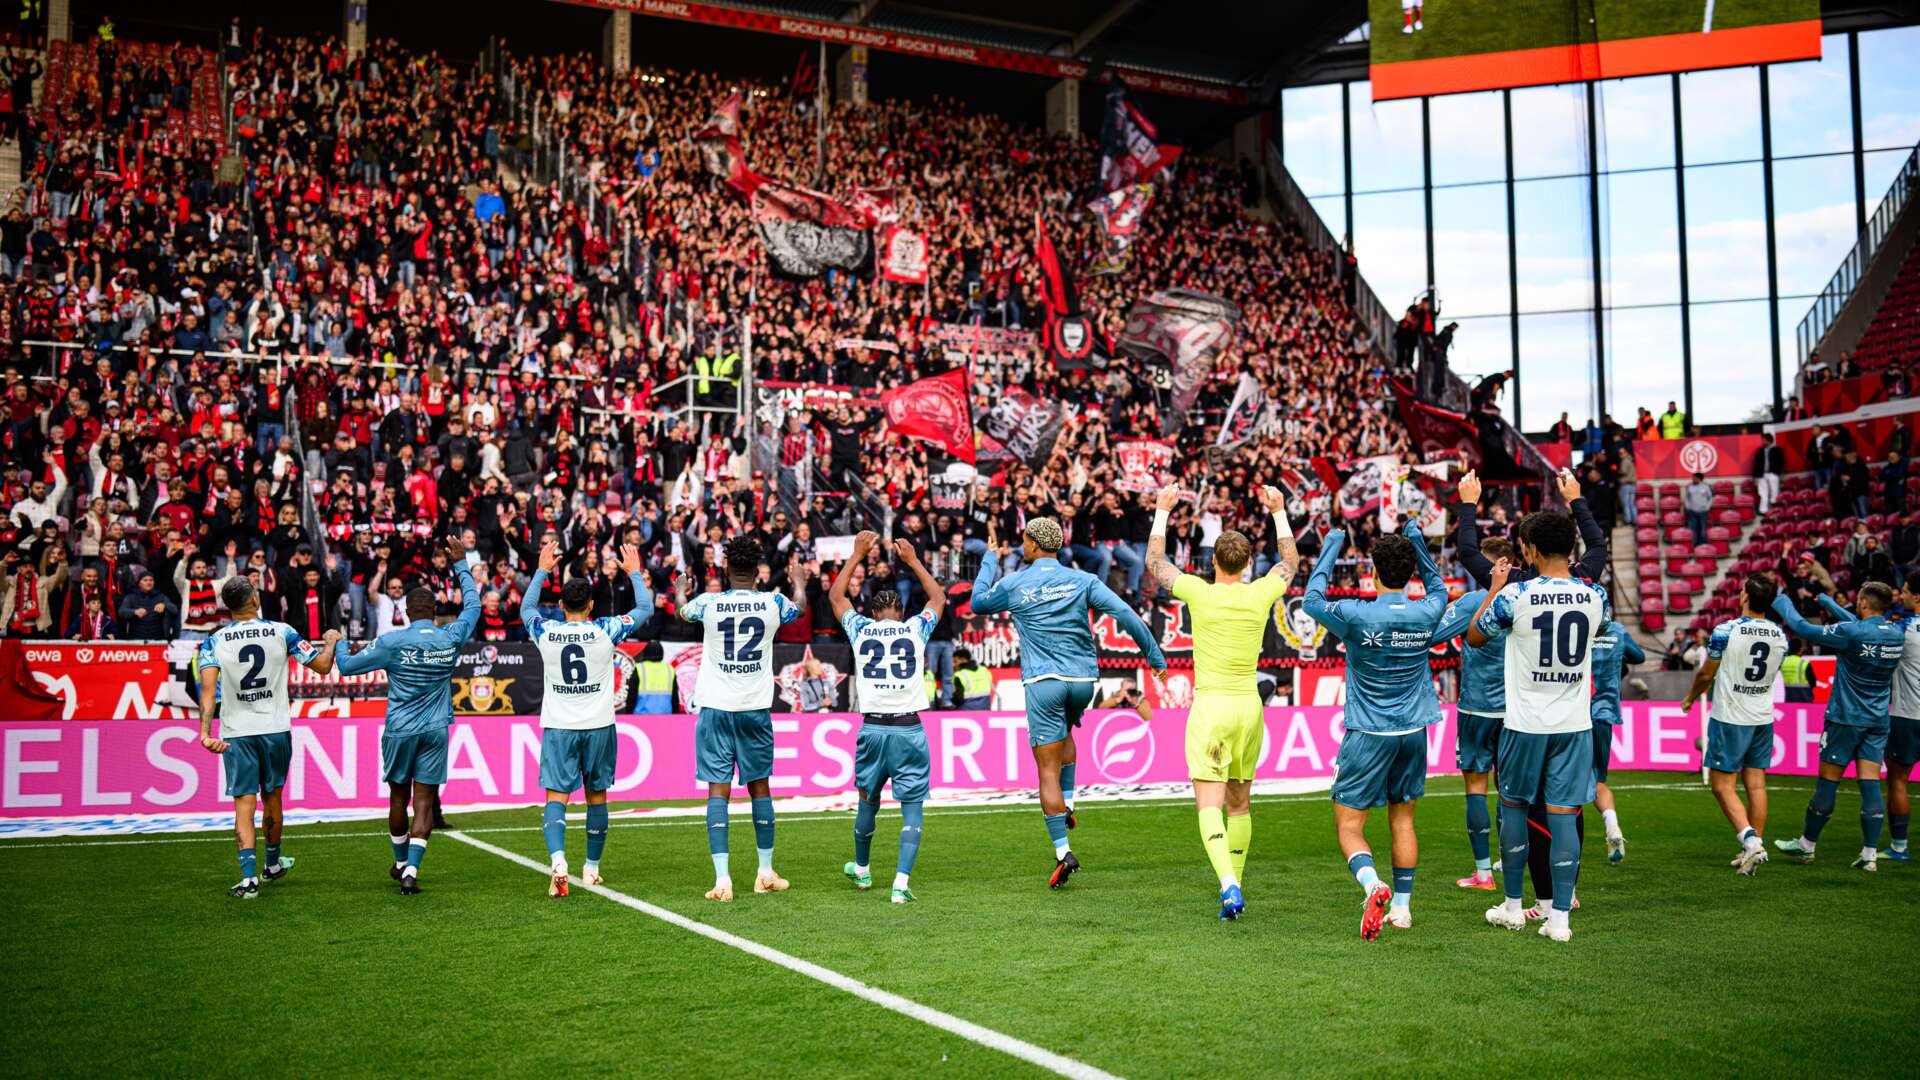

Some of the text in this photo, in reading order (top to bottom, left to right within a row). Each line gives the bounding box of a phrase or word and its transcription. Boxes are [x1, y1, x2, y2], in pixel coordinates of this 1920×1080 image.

[780, 19, 847, 39] ROCKLAND
[848, 31, 887, 46] RADIO
[896, 38, 935, 54] ROCKT
[1530, 593, 1591, 605] BAYER 04
[716, 602, 767, 612] BAYER 04
[225, 628, 275, 641] BAYER 04
[549, 632, 596, 642] BAYER 04
[864, 626, 911, 637] BAYER 04
[1740, 626, 1770, 637] BAYER
[717, 616, 765, 661] 12
[1532, 610, 1589, 667] 10
[26, 649, 62, 662] ewa
[859, 638, 916, 679] 23
[1744, 641, 1770, 682] 3
[238, 644, 267, 690] 2
[560, 643, 588, 684] 6
[717, 661, 762, 674] TAPSOBA
[1531, 671, 1583, 684] TILLMAN
[236, 689, 273, 703] MEDINA
